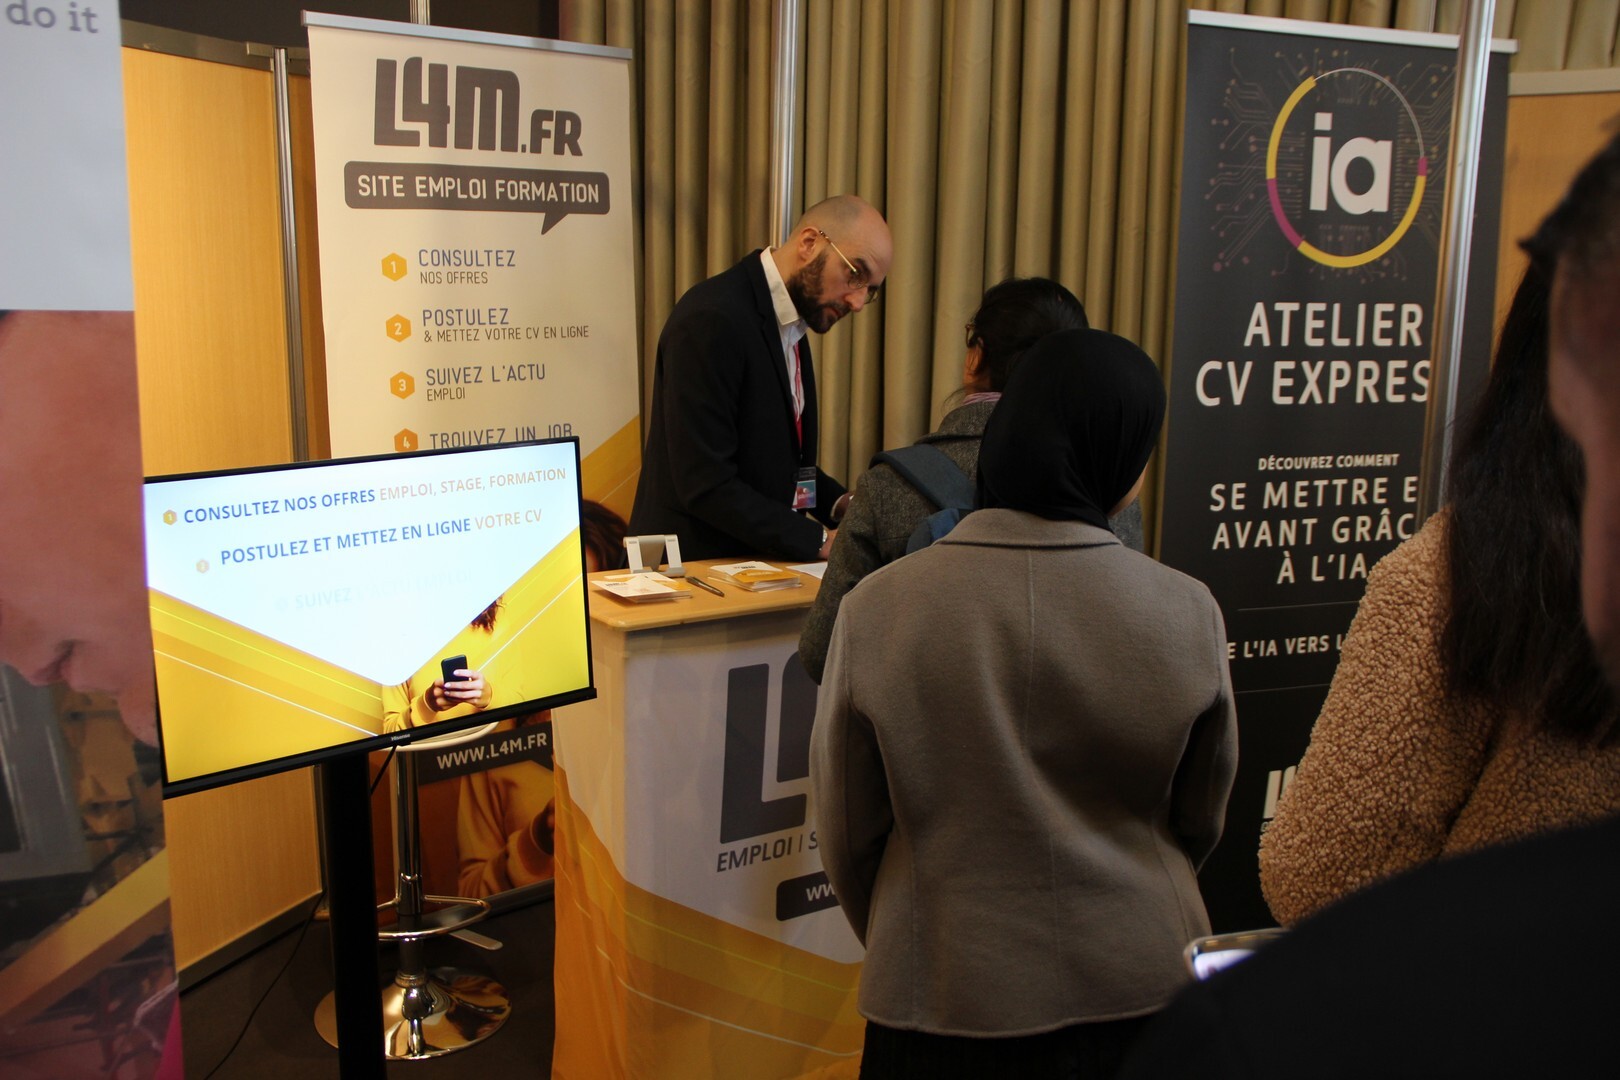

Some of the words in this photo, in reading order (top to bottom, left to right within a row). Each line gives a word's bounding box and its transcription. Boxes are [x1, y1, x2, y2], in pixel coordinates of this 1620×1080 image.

[6, 0, 56, 28] do
[69, 2, 98, 33] it
[374, 56, 583, 156] L4M.FR
[1310, 112, 1392, 215] ia
[358, 174, 405, 197] SITE
[416, 176, 487, 199] EMPLOI
[495, 179, 599, 203] FORMATION
[418, 249, 516, 267] CONSULTEZ
[420, 271, 442, 284] NOS
[446, 271, 488, 284] OFFRES
[422, 308, 509, 327] POSTULEZ
[424, 330, 432, 342] &
[437, 329, 480, 342] METTEZ
[485, 327, 521, 341] VOTRE
[526, 327, 540, 339] CV
[544, 326, 557, 339] EN
[561, 325, 589, 338] LIGNE
[1244, 302, 1423, 347] ATELIER
[426, 366, 483, 386] SUIVEZ
[491, 363, 546, 383] L'ACTU
[1196, 361, 1253, 407] CV
[1272, 359, 1432, 405] EXPRES
[427, 387, 465, 401] EMPLOI
[430, 428, 506, 449] TROUVEZ
[516, 426, 536, 441] UN
[1258, 455, 1333, 471] DÉCOUVREZ
[1336, 453, 1400, 468] COMMENT
[184, 500, 280, 524] CONSULTEZ
[284, 496, 317, 512] NOS
[321, 489, 376, 508] OFFRES
[379, 482, 437, 501] EMPLOI,
[441, 475, 485, 494] STAGE,
[489, 467, 567, 488] FORMATION
[1210, 482, 1246, 512] SE
[1263, 477, 1389, 509] METTRE
[1403, 476, 1418, 503] E
[221, 540, 309, 565] POSTULEZ
[313, 536, 332, 553] ET
[336, 528, 397, 549] METTEZ
[401, 525, 422, 541] EN
[427, 518, 471, 537] LIGNE
[475, 511, 521, 530] VOTRE
[525, 509, 543, 525] CV
[1212, 518, 1318, 550] AVANT
[1331, 508, 1415, 543] GRÂC
[1277, 551, 1295, 585] À
[295, 588, 353, 609] SUIVEZ
[1227, 642, 1237, 659] E
[1244, 639, 1278, 658] L'IA
[1285, 635, 1330, 655] VERS
[437, 732, 547, 770] WWW.L4M.FR
[717, 837, 792, 872] EMPLOI
